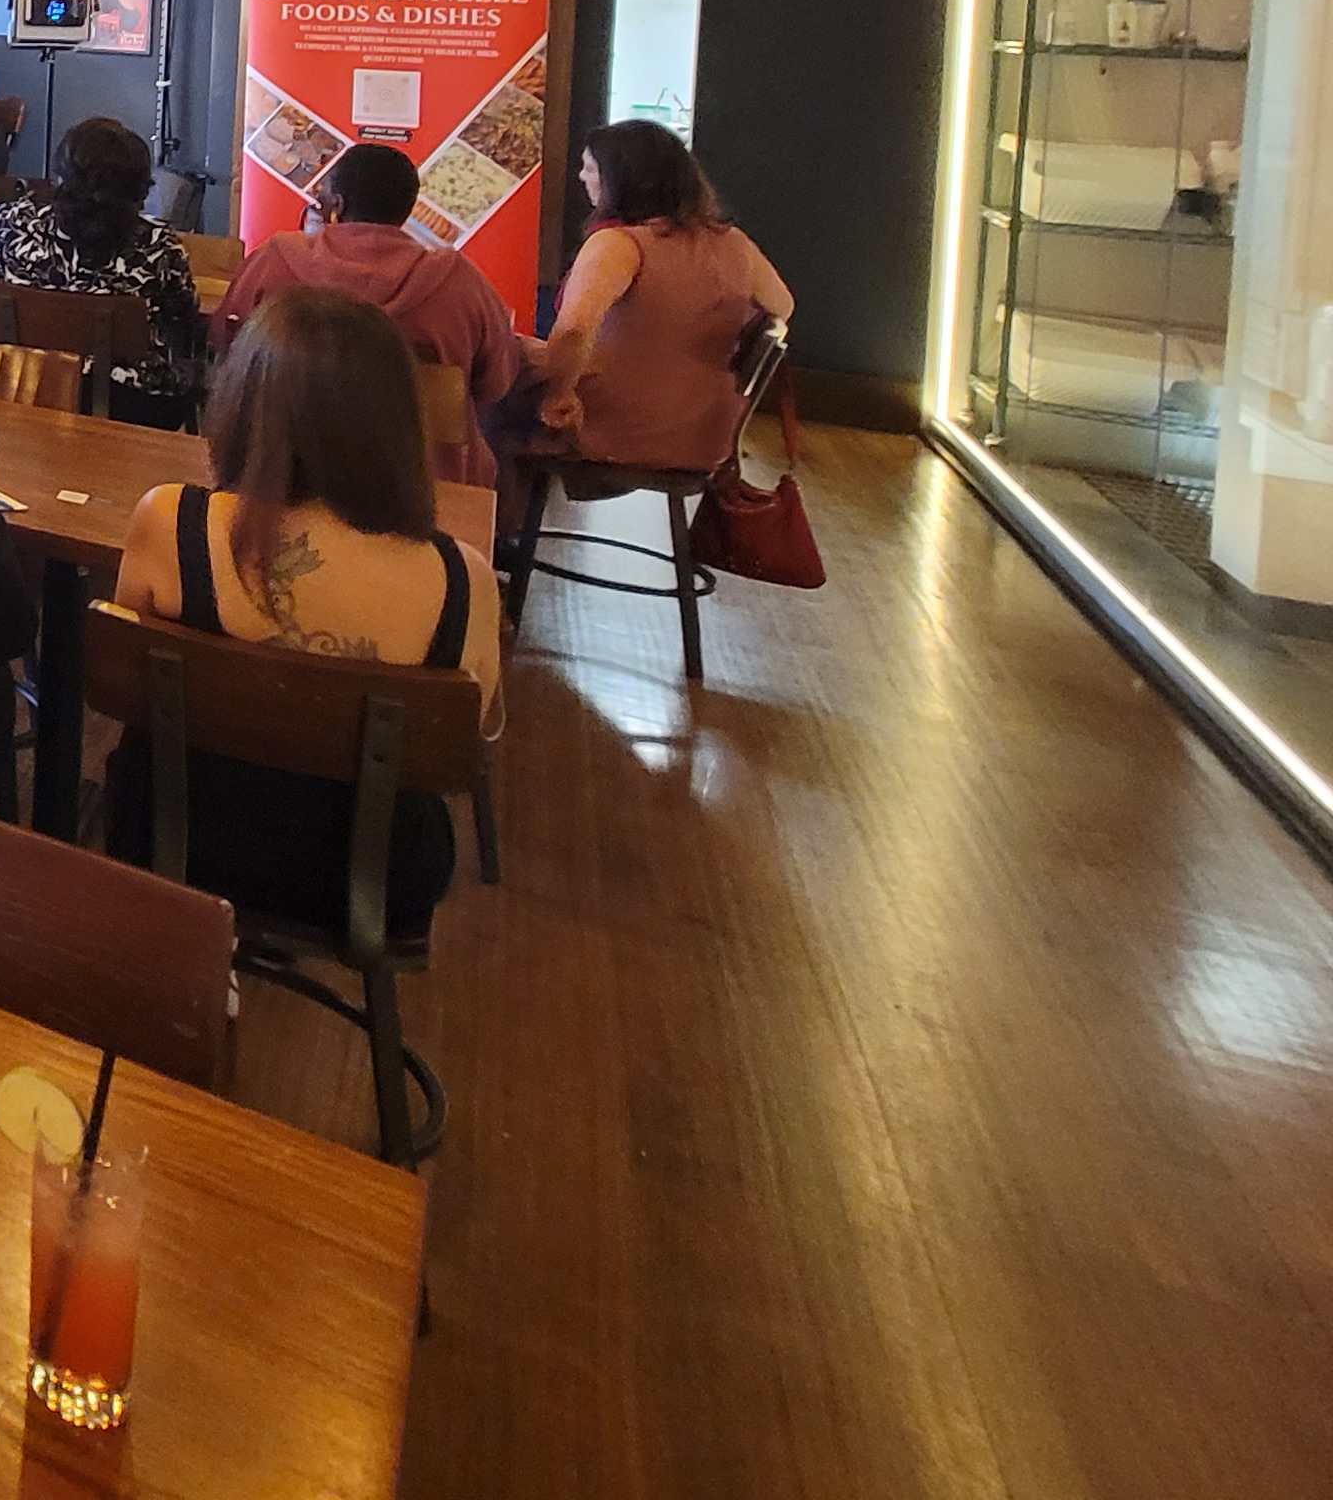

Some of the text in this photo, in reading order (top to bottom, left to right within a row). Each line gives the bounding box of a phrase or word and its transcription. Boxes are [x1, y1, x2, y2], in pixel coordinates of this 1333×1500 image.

[281, 3, 502, 26] FOODS & DISHES
